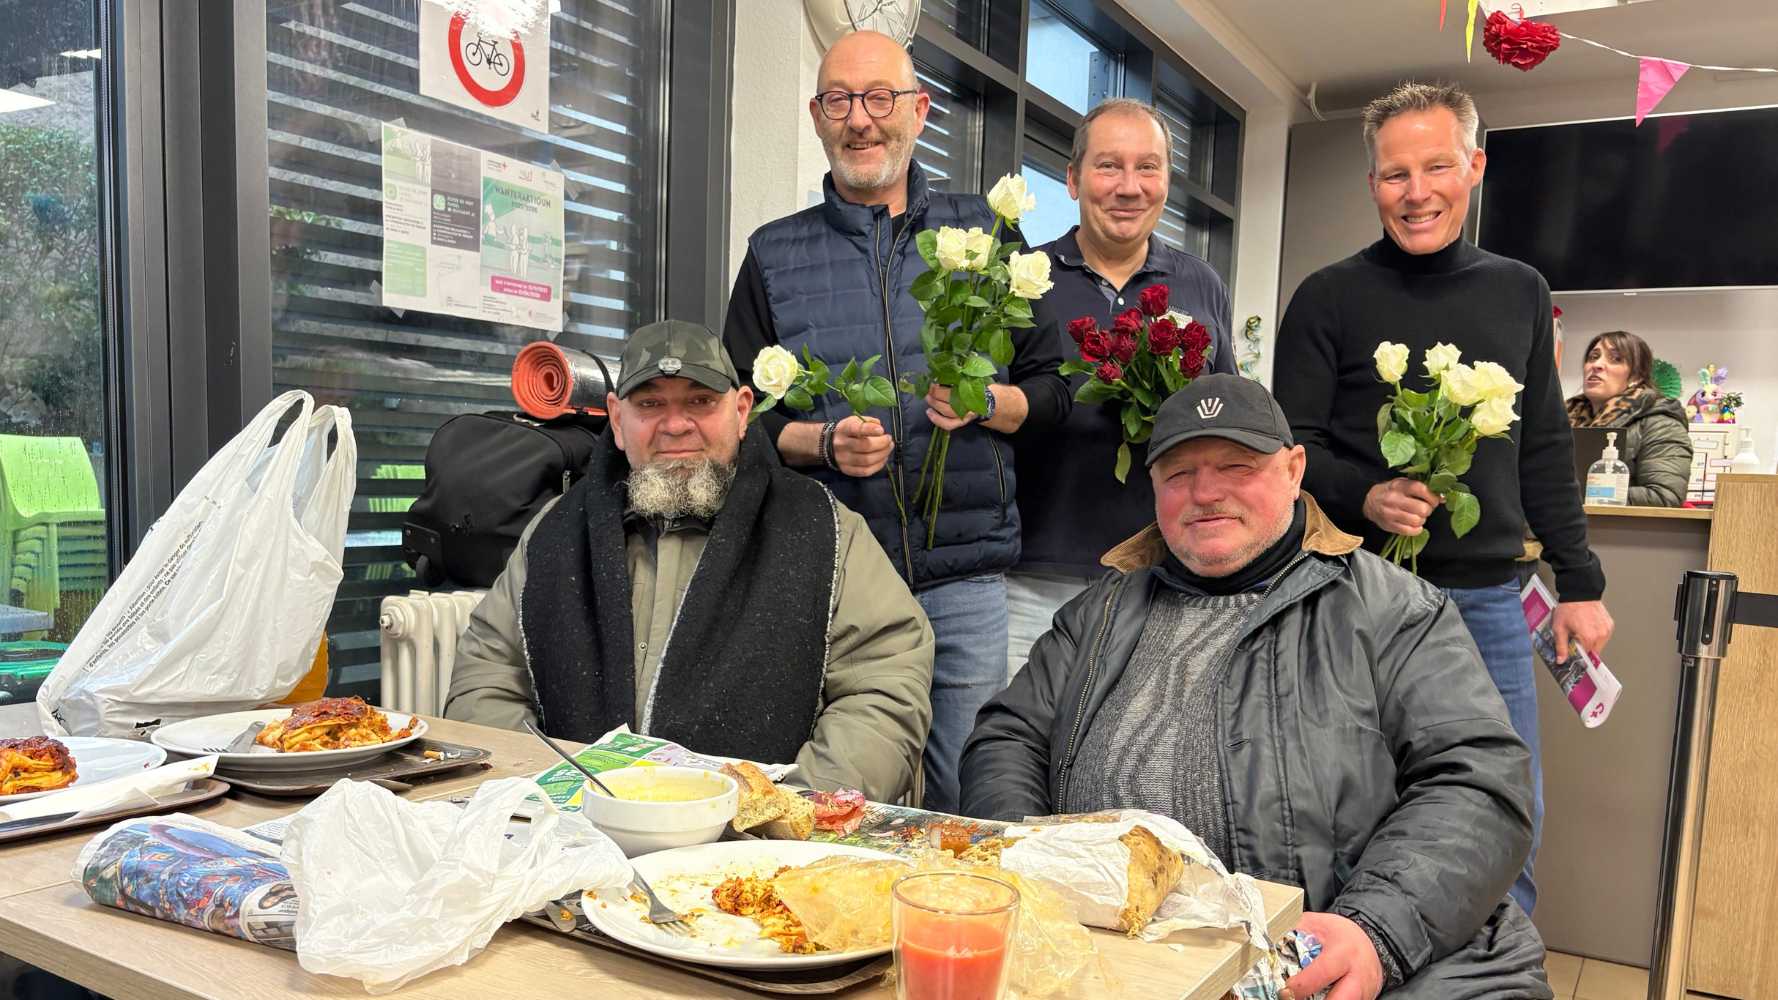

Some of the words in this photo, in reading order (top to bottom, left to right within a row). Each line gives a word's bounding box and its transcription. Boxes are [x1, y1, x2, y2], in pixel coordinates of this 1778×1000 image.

[494, 185, 551, 208] WANTERAKTIOUN
[129, 591, 146, 610] Attention
[168, 548, 180, 563] danger
